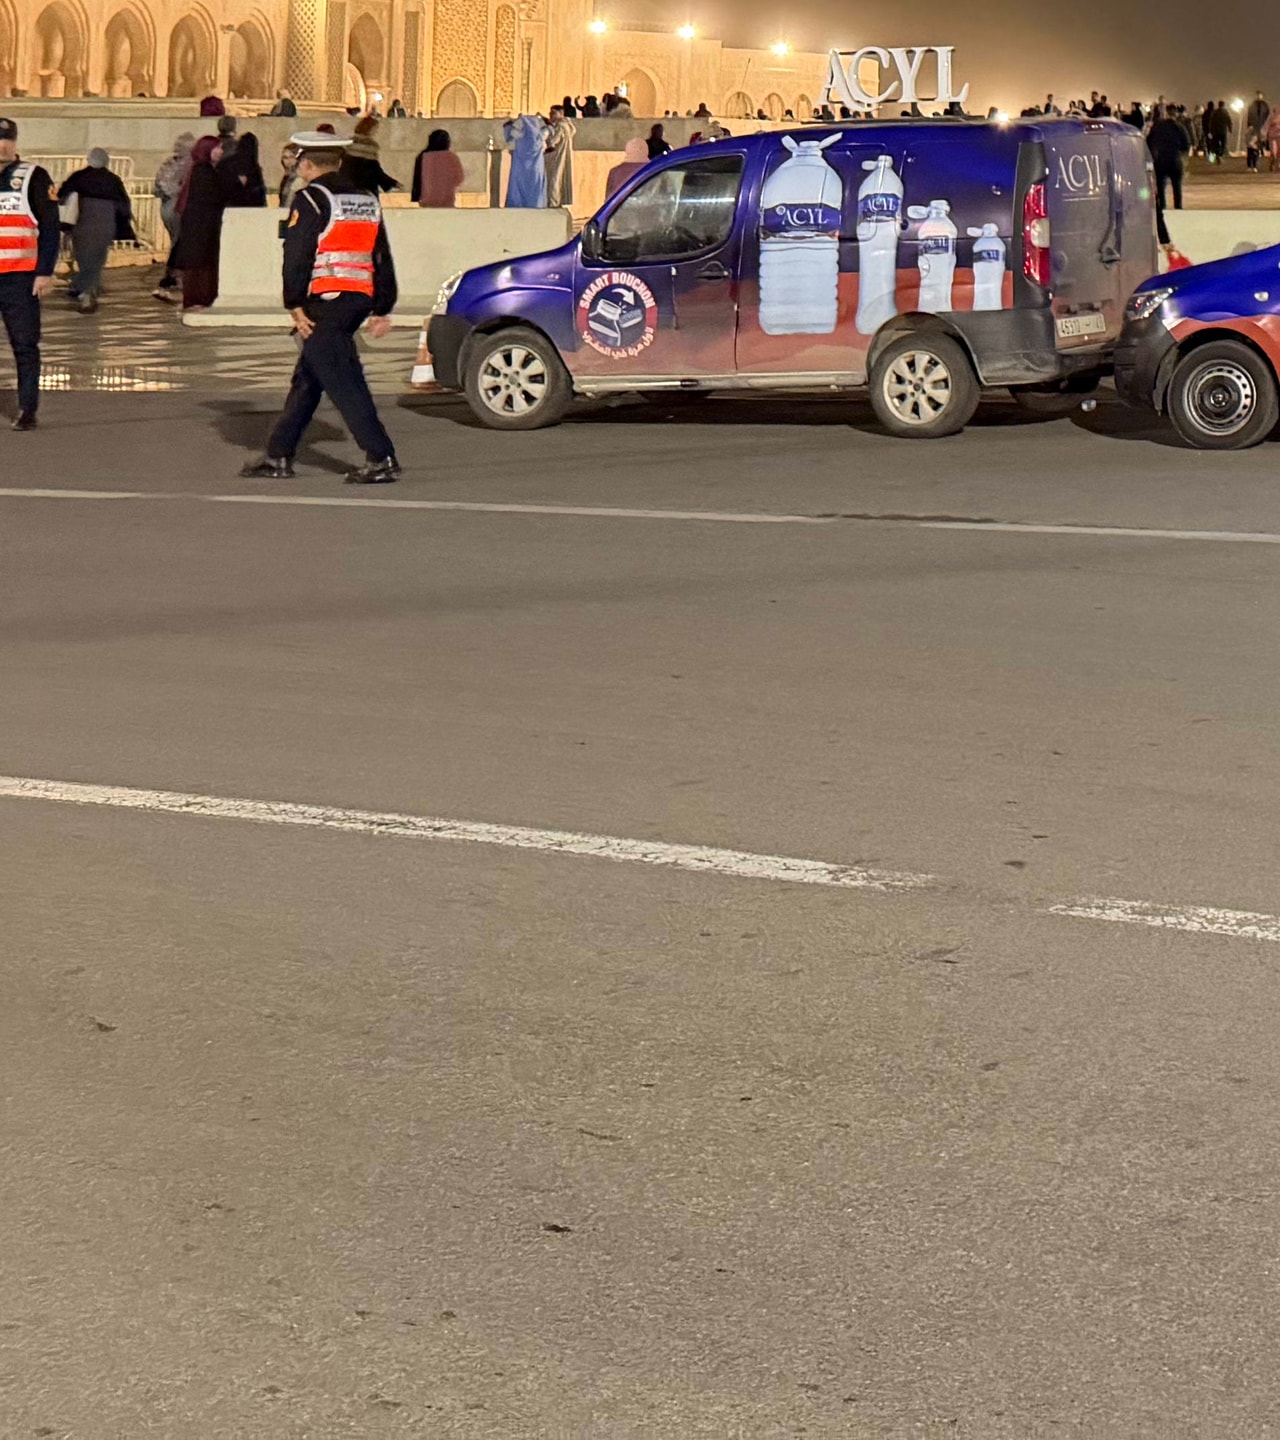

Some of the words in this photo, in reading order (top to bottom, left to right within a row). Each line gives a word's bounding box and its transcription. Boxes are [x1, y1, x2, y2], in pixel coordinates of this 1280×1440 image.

[816, 46, 969, 112] ACYL
[1055, 154, 1107, 191] ACYL
[781, 208, 830, 226] ACYL
[580, 274, 610, 309] SMART
[612, 271, 656, 308] BOUCHON
[612, 350, 627, 359] في
